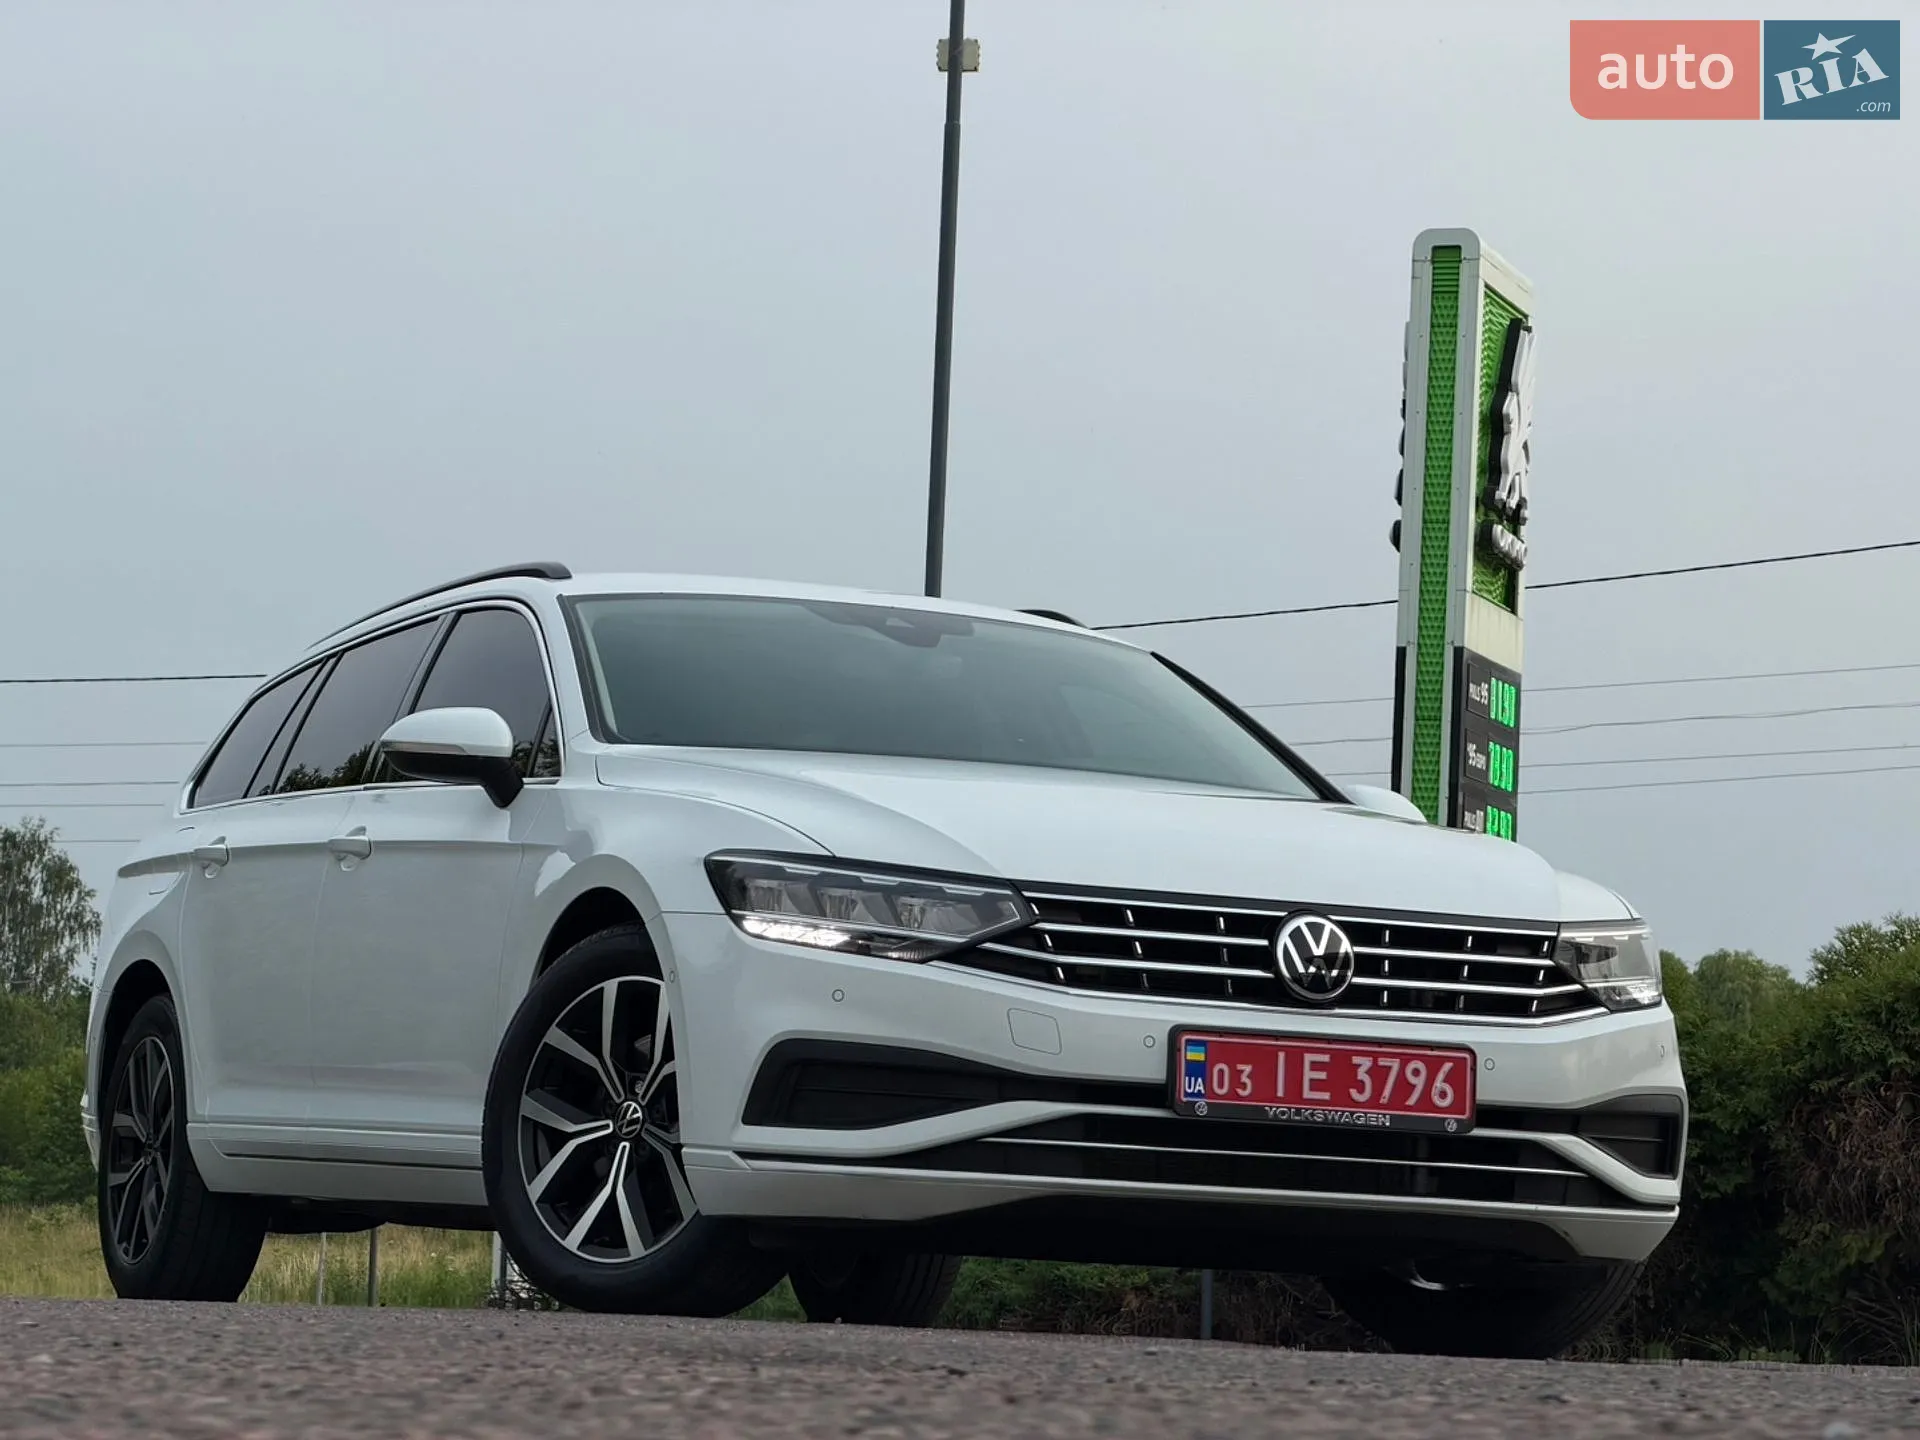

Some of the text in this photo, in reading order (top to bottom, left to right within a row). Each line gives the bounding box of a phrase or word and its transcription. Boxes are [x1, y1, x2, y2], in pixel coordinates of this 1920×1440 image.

[1185, 1051, 1455, 1109] UA 03 IE 3796
[1263, 1106, 1391, 1128] VOLKSWAGEN
